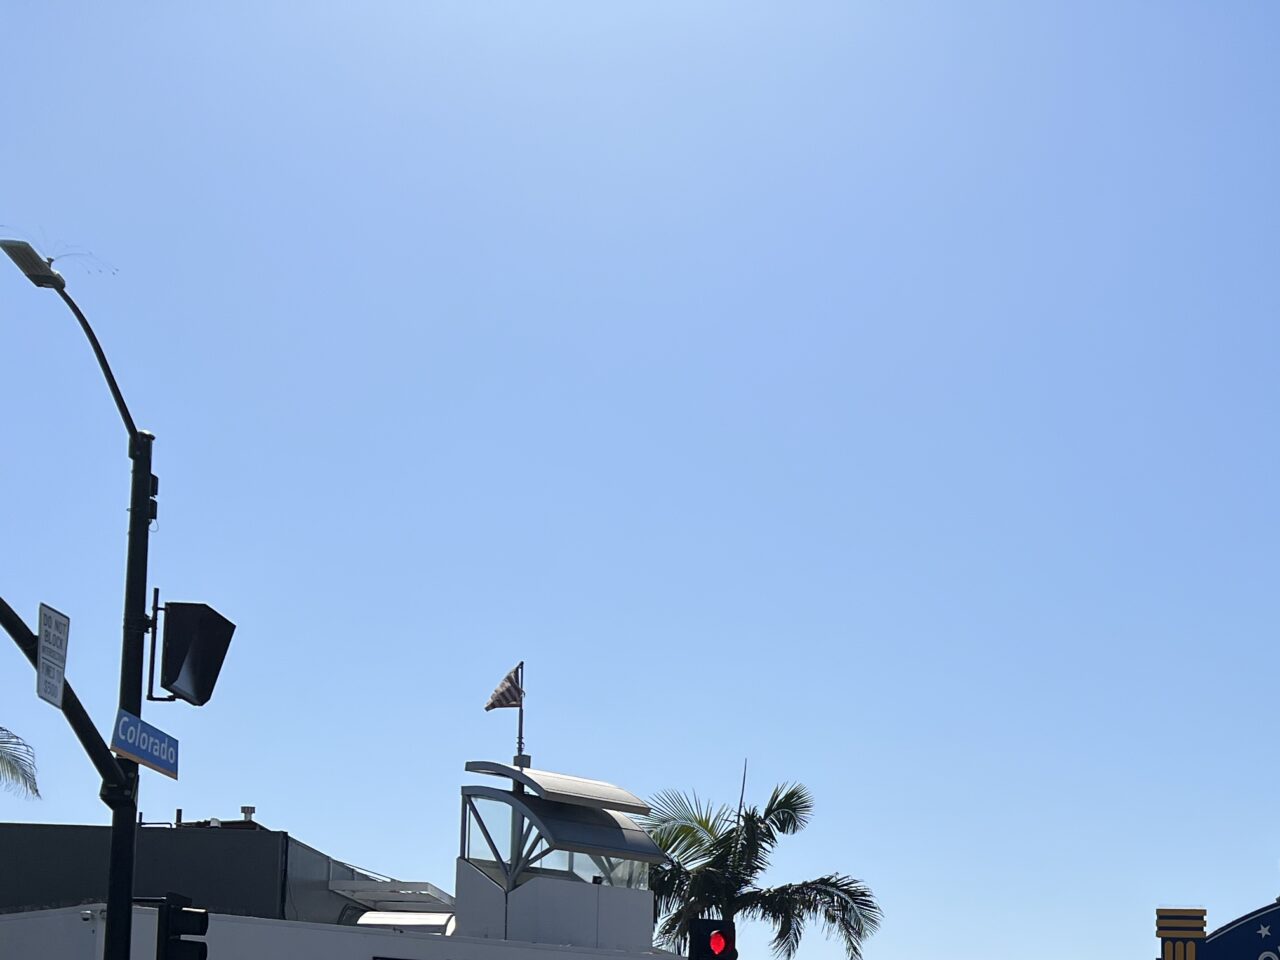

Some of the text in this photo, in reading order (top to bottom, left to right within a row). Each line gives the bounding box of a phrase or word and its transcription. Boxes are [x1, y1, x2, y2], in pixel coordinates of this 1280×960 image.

[43, 613, 67, 637] DO NOT
[45, 629, 64, 649] BLOCK
[118, 716, 176, 764] Colorado
